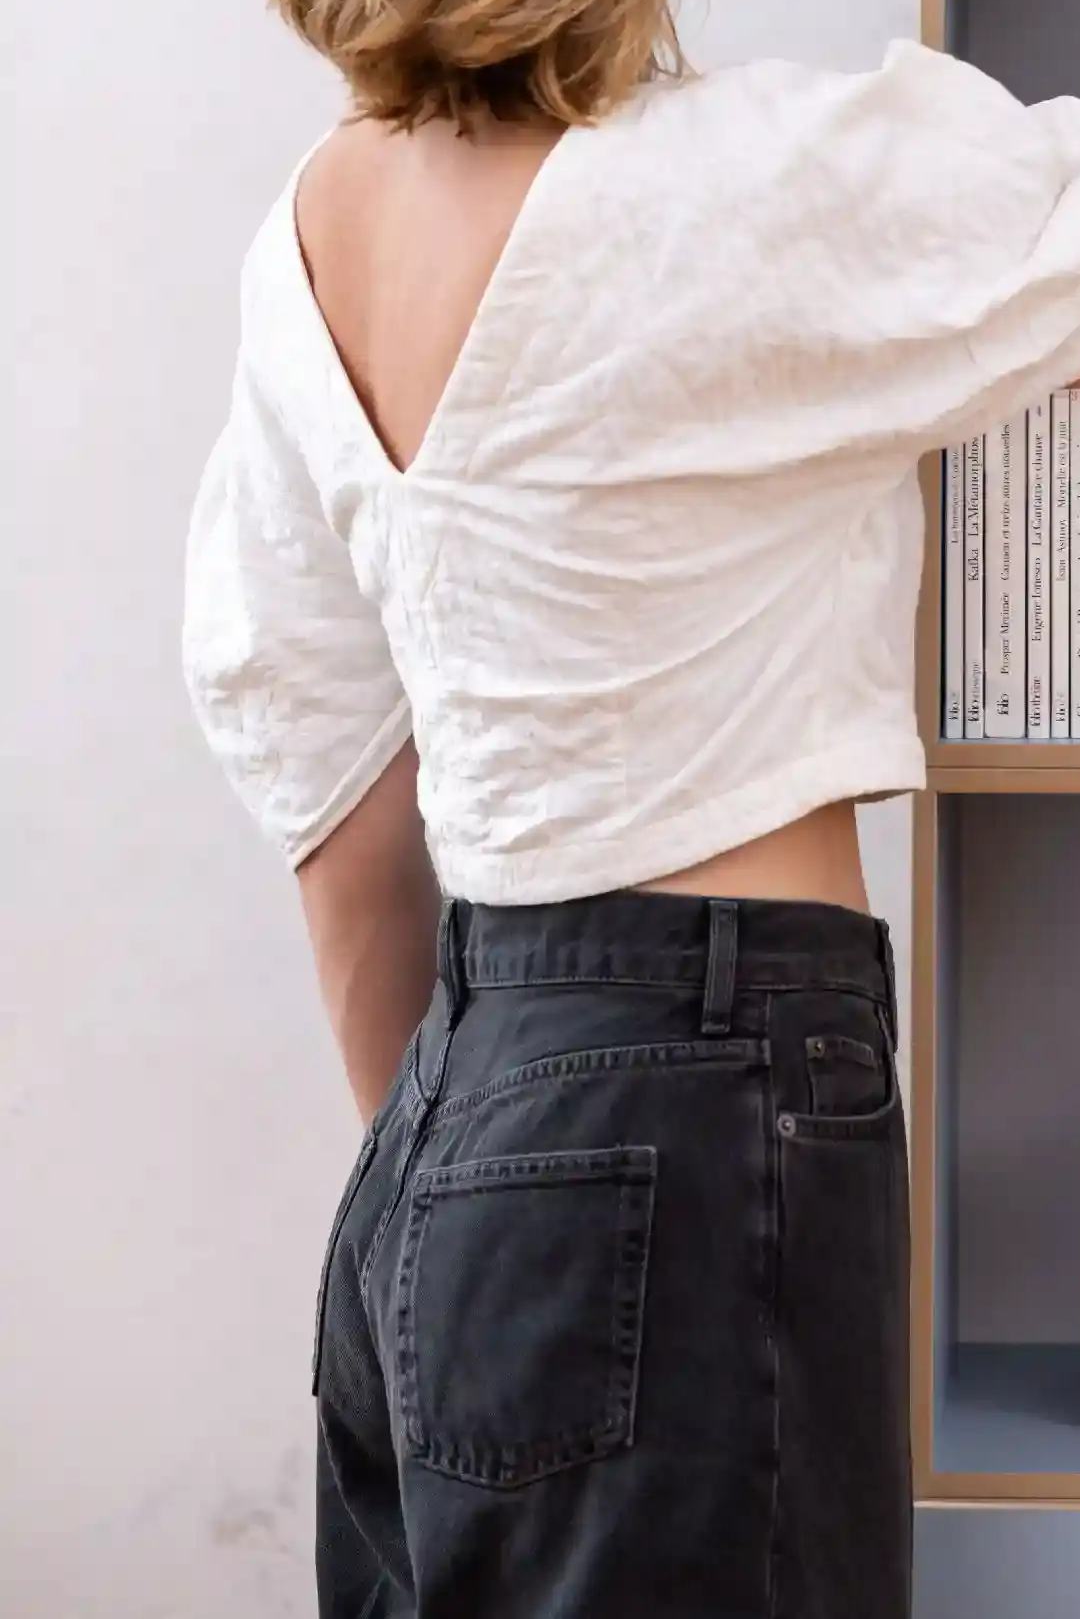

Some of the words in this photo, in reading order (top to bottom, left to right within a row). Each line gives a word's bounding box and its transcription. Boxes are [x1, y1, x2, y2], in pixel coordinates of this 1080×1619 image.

[1031, 434, 1043, 472] chauve
[967, 436, 982, 521] Métamorphos
[967, 522, 980, 537] La
[1031, 529, 1042, 546] La
[968, 549, 980, 581] Kafka
[996, 694, 1010, 716] folio
